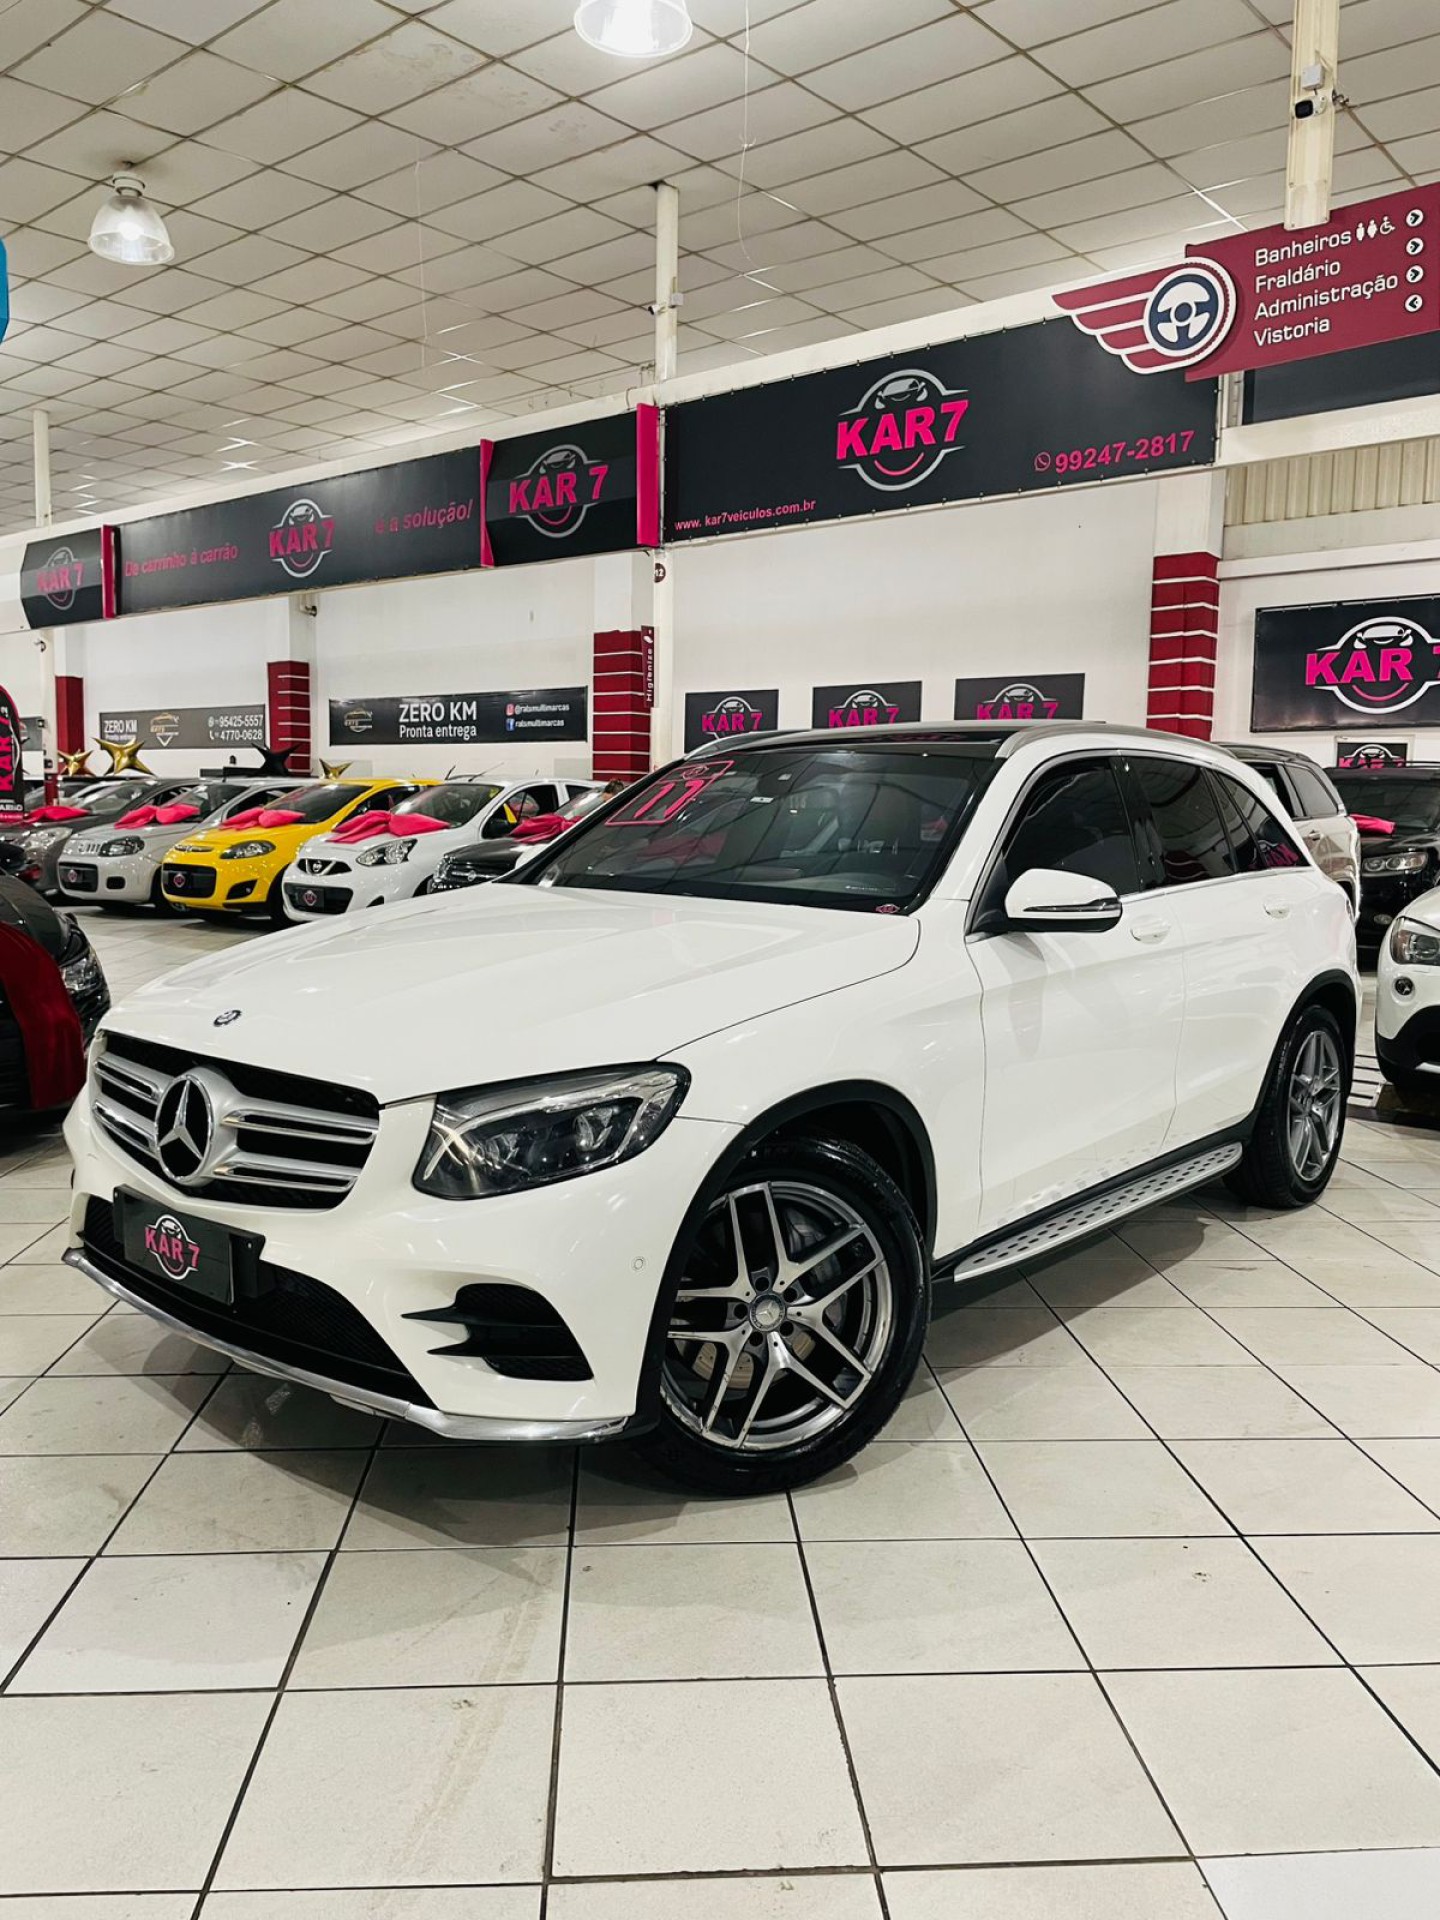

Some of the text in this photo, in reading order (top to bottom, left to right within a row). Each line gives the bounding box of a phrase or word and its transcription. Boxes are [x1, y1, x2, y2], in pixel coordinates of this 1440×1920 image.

[1255, 231, 1352, 267] Banheiros
[1255, 259, 1341, 294] Fraldário
[1254, 274, 1398, 321] Administração
[1253, 317, 1330, 347] Vistoria
[1055, 430, 1195, 474] 99247-2817
[508, 464, 609, 514] KAR 7
[403, 499, 474, 530] solução!
[705, 499, 816, 527] kar7veiculos.com.br
[268, 518, 335, 558] KAR 7
[37, 561, 84, 592] KAR 7
[646, 648, 654, 702] Higienize
[1305, 647, 1414, 687] KAR
[104, 719, 125, 733] ZERO
[125, 719, 138, 733] KM
[398, 701, 477, 722] ZERO KM
[702, 711, 763, 732] KAR 7
[828, 706, 901, 729] KAR 7
[975, 700, 1060, 721] KAR 7
[399, 724, 477, 741] Pronta entrega
[145, 1227, 201, 1268] KAR 7
